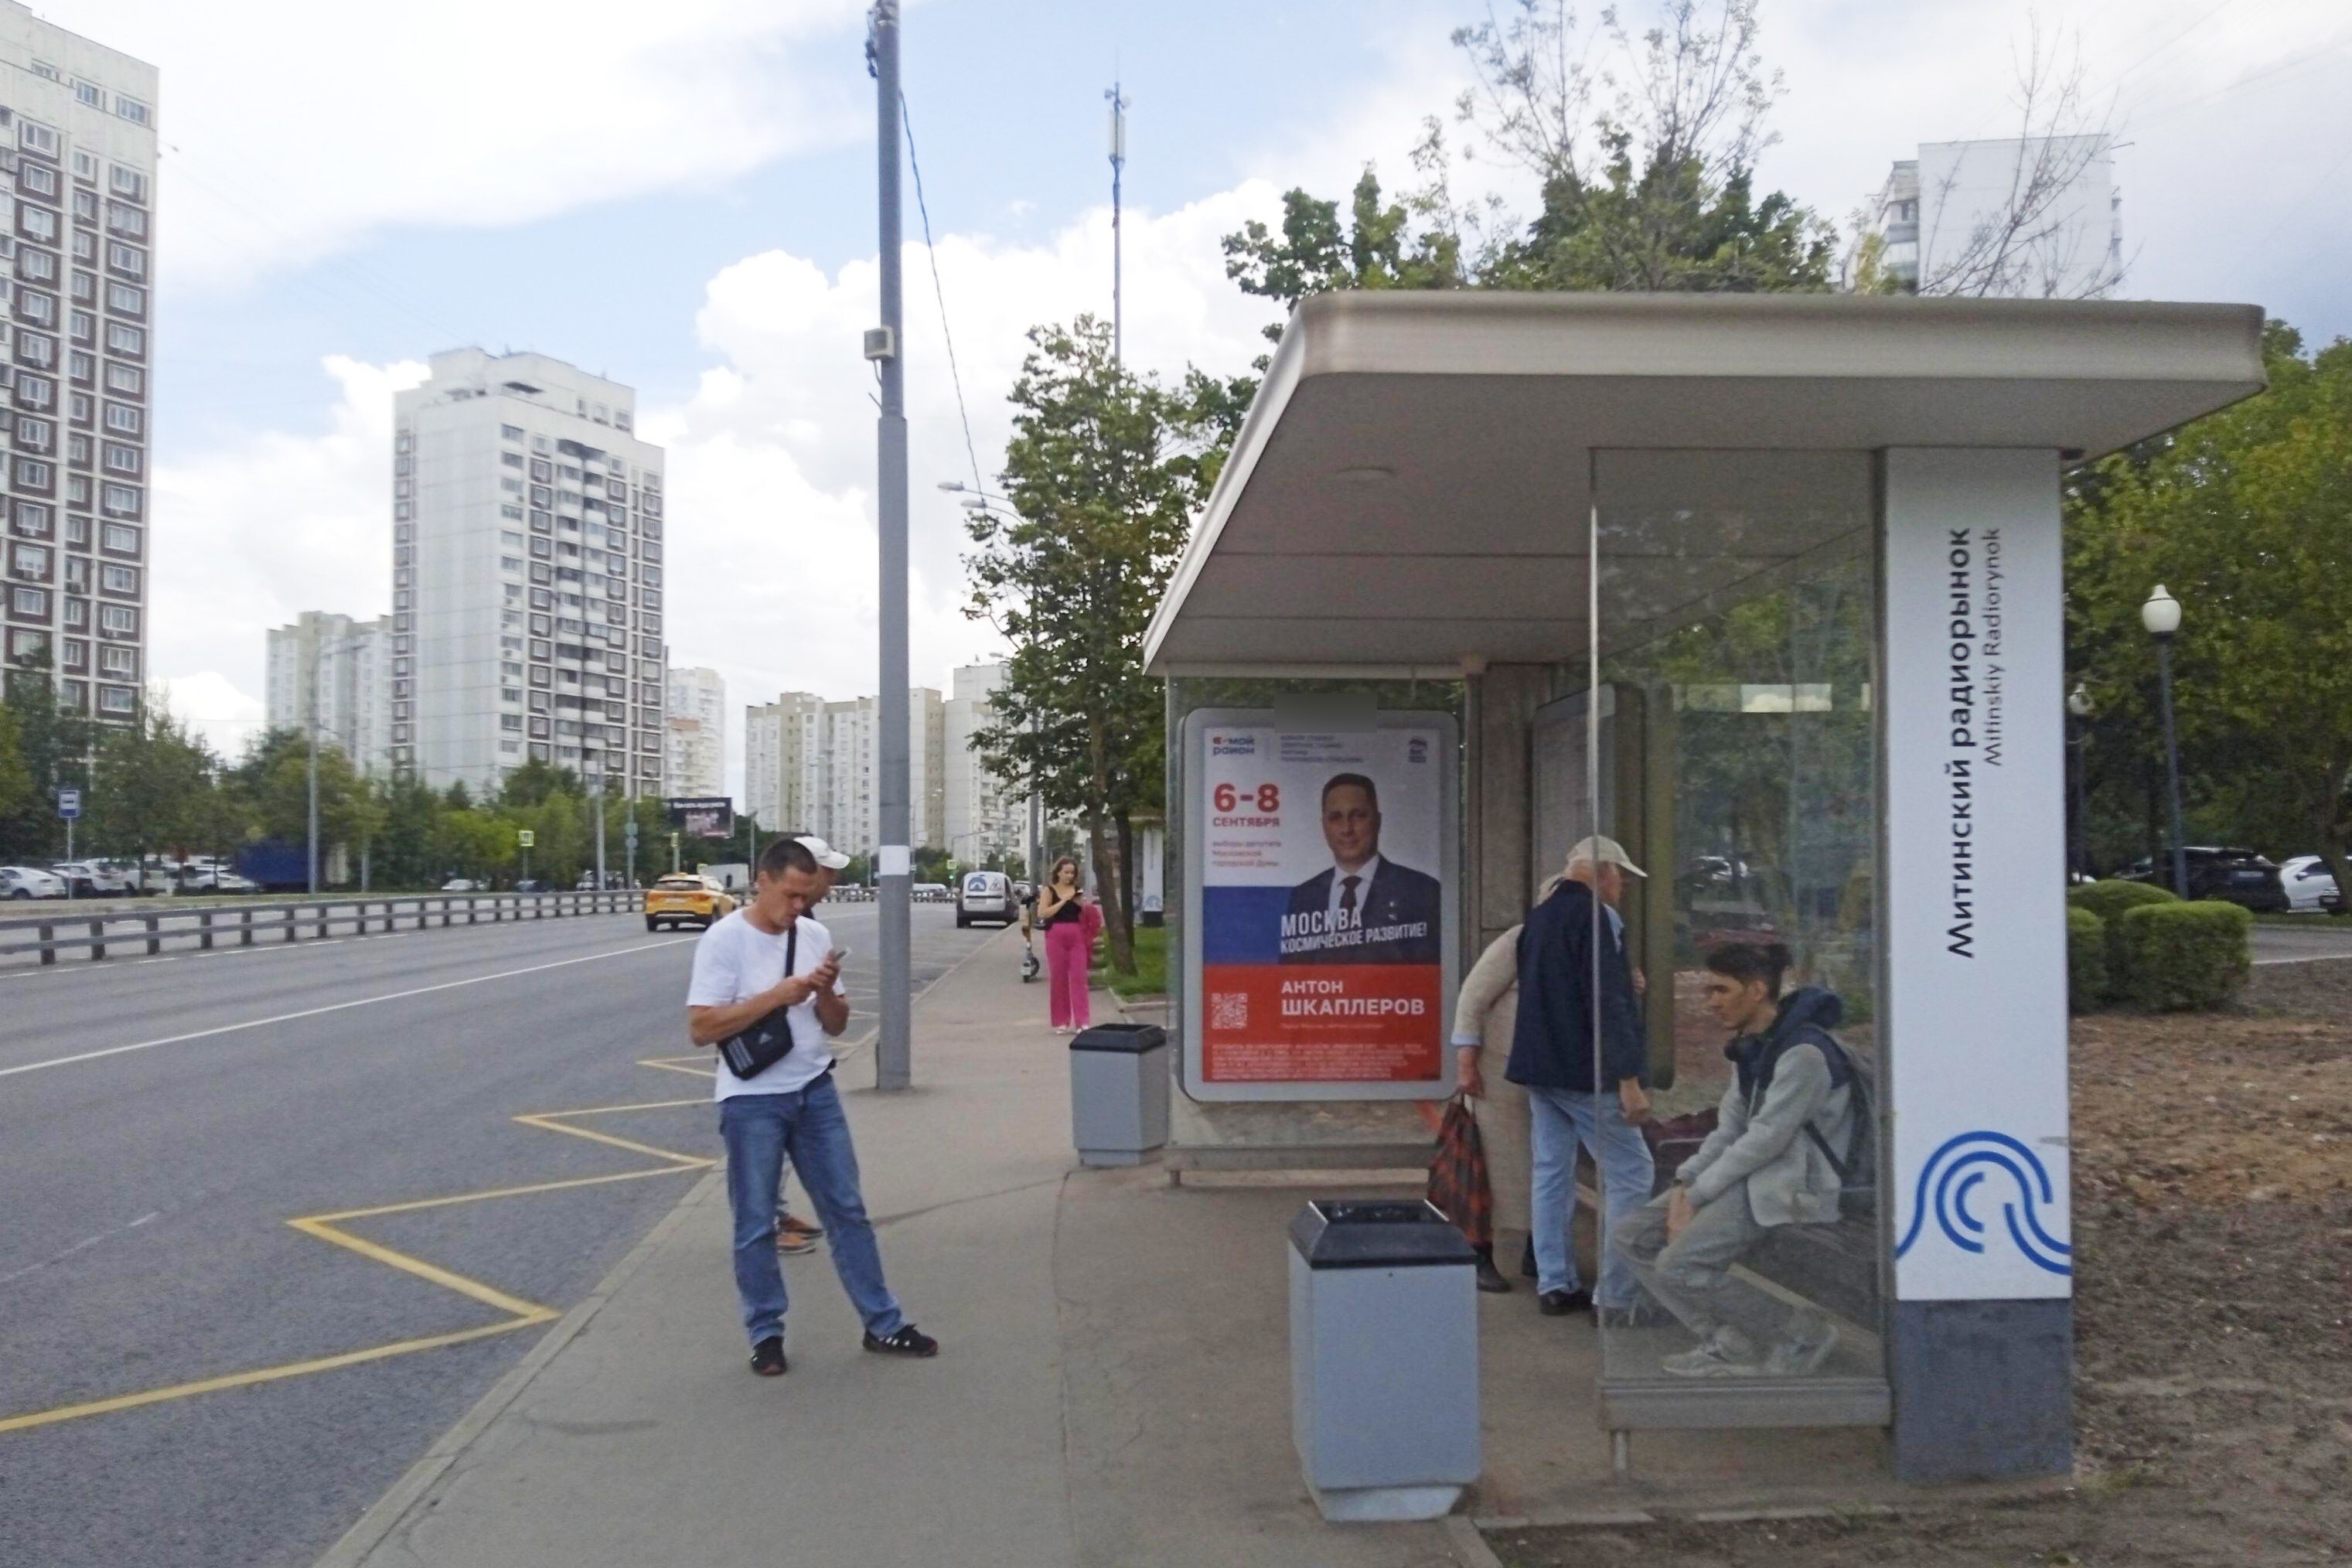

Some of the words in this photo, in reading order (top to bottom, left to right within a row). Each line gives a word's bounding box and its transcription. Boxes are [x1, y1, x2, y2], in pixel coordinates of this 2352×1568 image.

[1980, 528, 2005, 656] Radiorynok
[1949, 528, 1978, 748] радиорынок
[1981, 663, 2006, 767] Mitinskiy
[1212, 816, 1280, 828] СЕНТЯБРЯ
[1944, 759, 1974, 959] Митинский
[1280, 907, 1362, 938] МОСКВА
[1280, 929, 1364, 954] КОСМИЧЕСКОЕ
[1365, 921, 1428, 944] РАЗВИТИЕ!
[1281, 980, 1344, 994] АНТОН
[1281, 998, 1425, 1016] ШКАПЛЕРОВ
